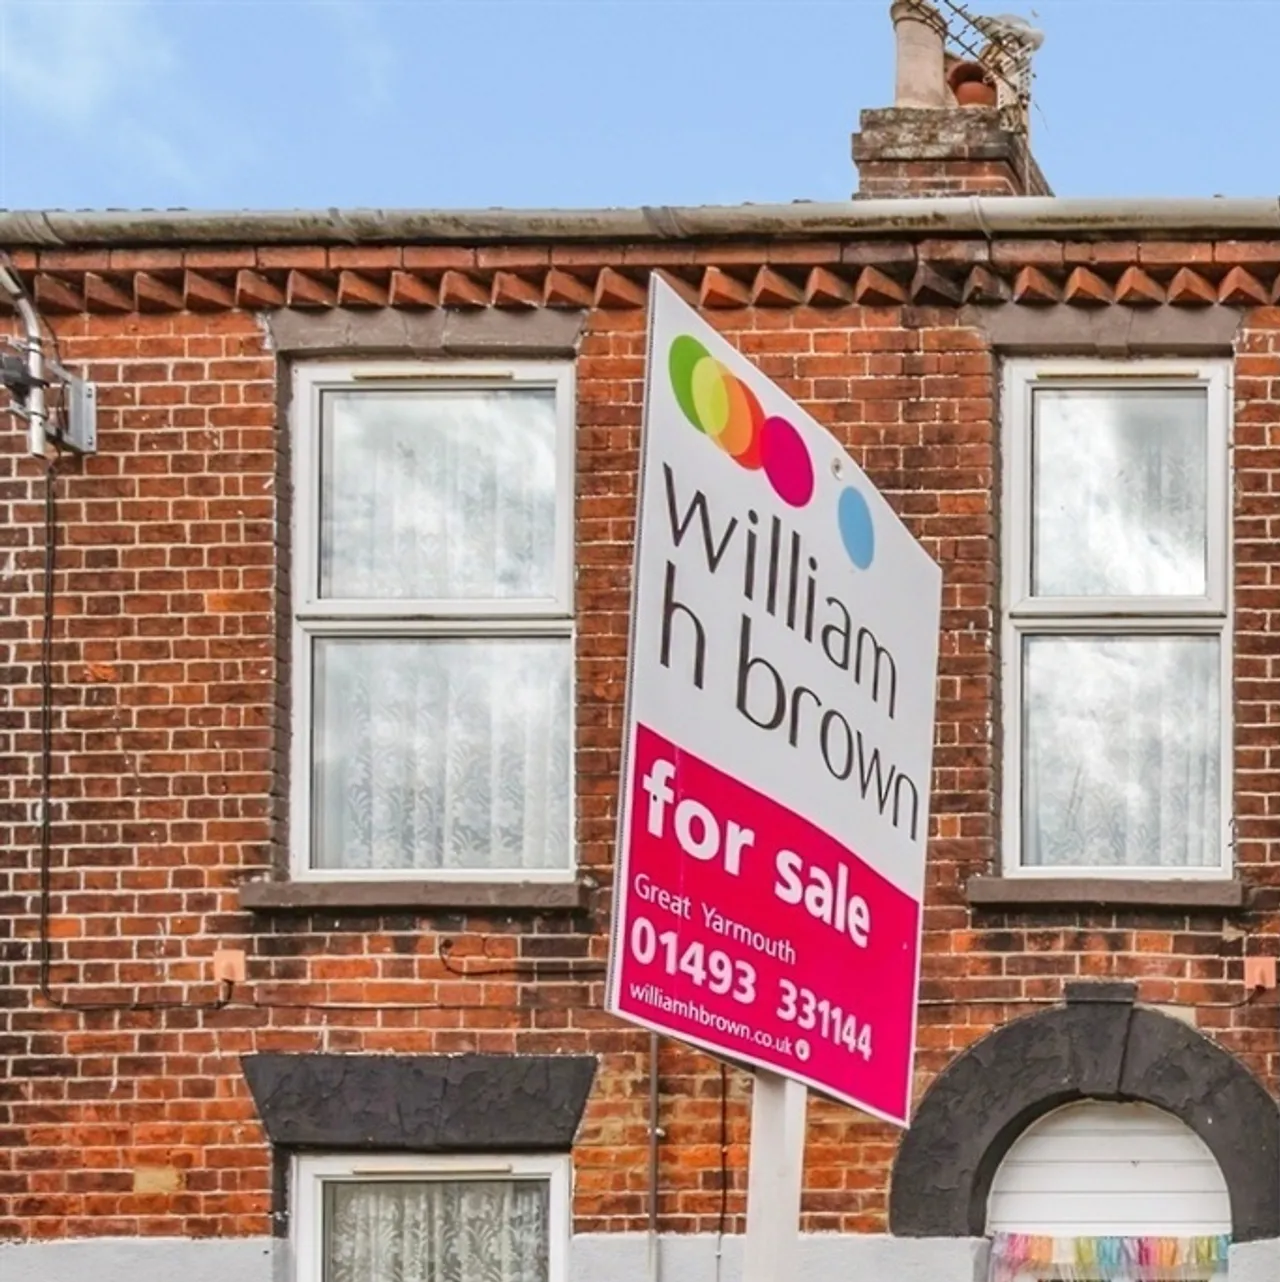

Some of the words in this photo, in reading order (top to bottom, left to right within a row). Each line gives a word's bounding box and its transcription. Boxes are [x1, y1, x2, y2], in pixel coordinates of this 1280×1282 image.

[662, 461, 897, 720] william
[660, 559, 707, 690] h
[736, 613, 919, 842] brown
[634, 872, 692, 920] Great
[701, 902, 797, 965] Yarmouth
[642, 758, 756, 877] for
[773, 849, 871, 949] sale
[629, 982, 793, 1054] williamhbrown.co.uk
[631, 916, 757, 1005] 01493
[776, 978, 873, 1062] 331144
